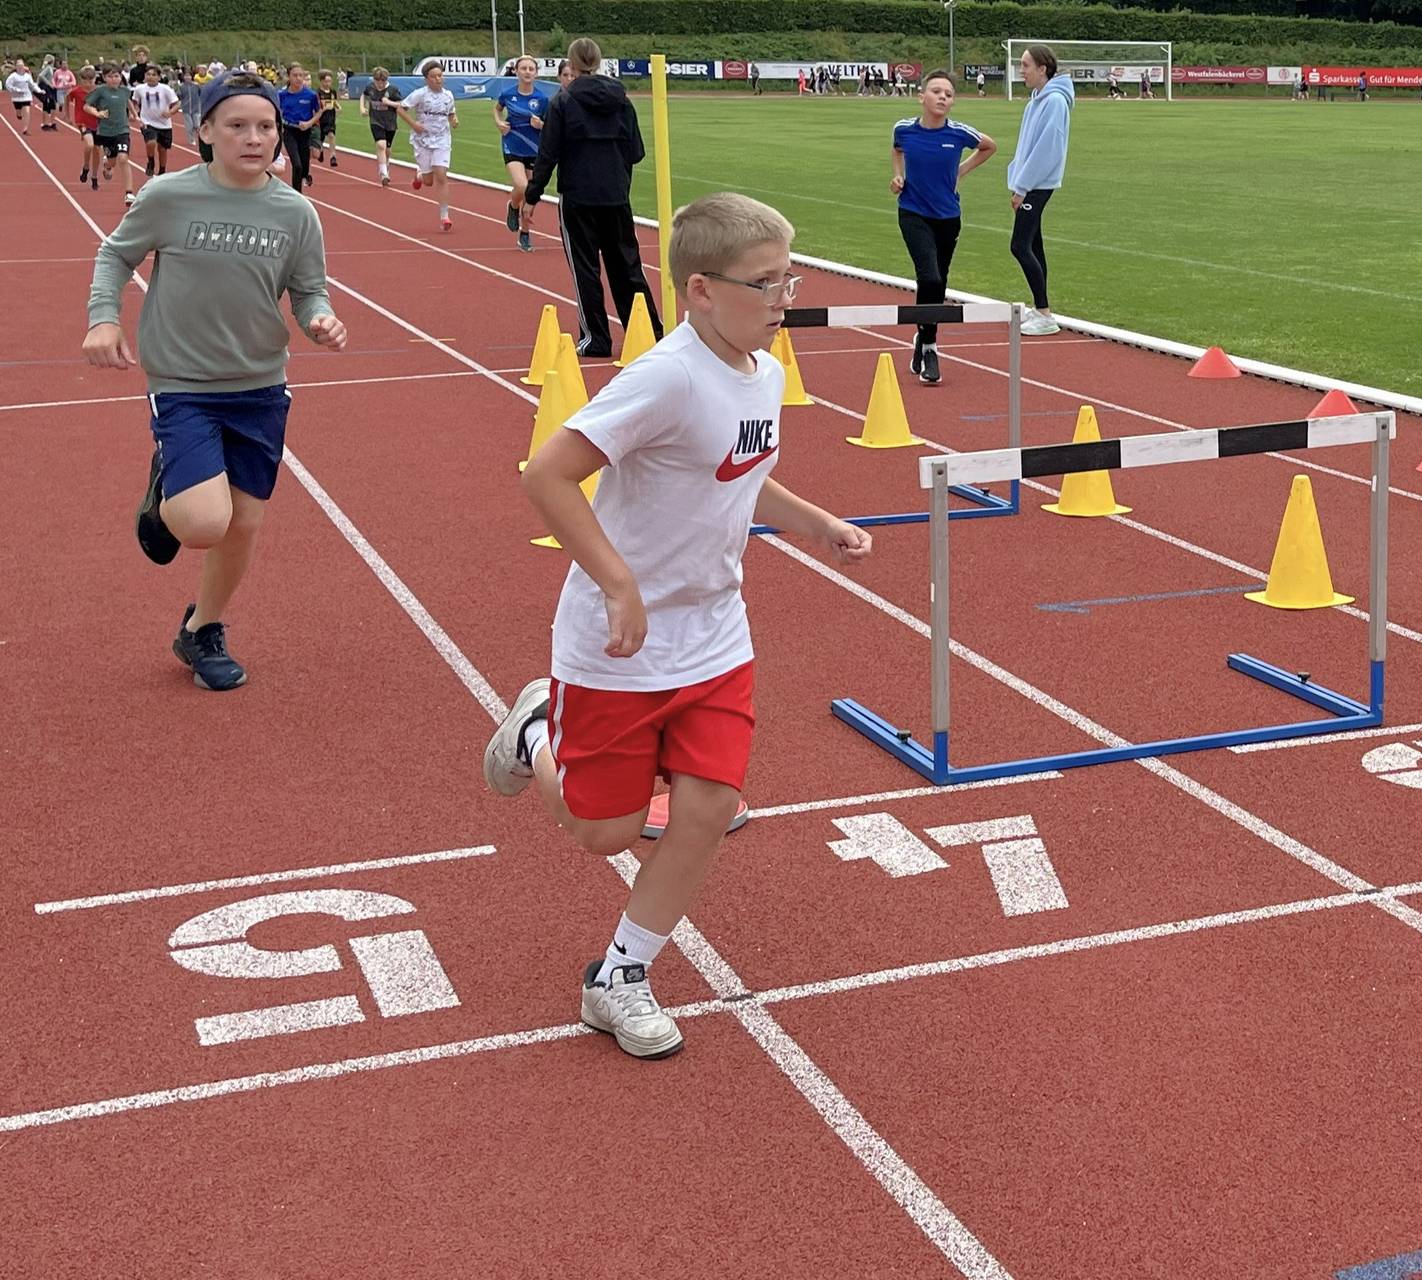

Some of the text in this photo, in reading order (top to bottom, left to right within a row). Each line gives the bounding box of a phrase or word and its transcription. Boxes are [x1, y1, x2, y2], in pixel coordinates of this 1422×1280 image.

[440, 59, 486, 73] VELTINS
[648, 63, 708, 75] SIER
[1187, 69, 1245, 78] Westfalenbäckerei
[1369, 75, 1383, 84] Gut
[1384, 74, 1395, 84] für
[117, 142, 128, 152] 12
[184, 221, 290, 258] BEYOND
[198, 232, 279, 248] AWESOME
[734, 420, 773, 454] NIKE
[826, 811, 1070, 918] 4
[168, 888, 461, 1046] 5
